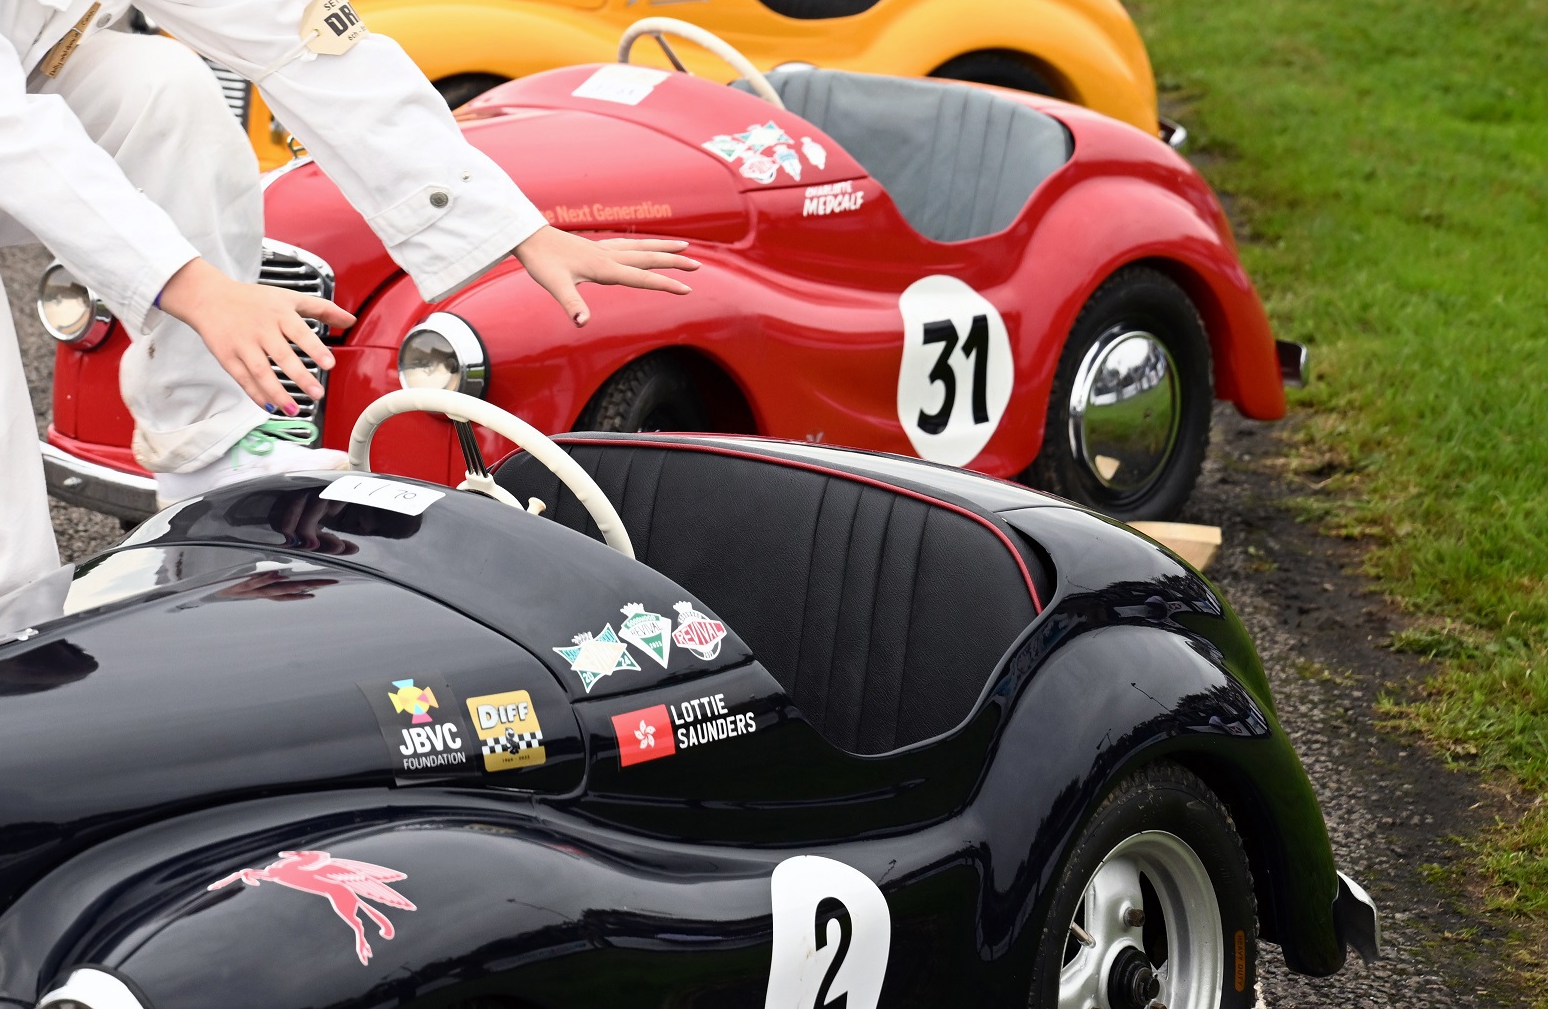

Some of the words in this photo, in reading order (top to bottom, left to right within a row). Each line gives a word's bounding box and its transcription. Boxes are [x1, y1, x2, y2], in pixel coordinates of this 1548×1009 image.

[555, 204, 592, 223] Next
[592, 201, 672, 221] Generation
[803, 191, 865, 217] MEDCALF
[916, 313, 989, 435] 31
[630, 622, 663, 637] REVIVAL
[676, 621, 724, 646] REVIVAL
[583, 671, 594, 683] 20
[476, 701, 530, 730] DIFF
[670, 693, 729, 726] LOTTIE
[399, 722, 463, 756] JBVC
[677, 711, 757, 749] SAUNDERS
[403, 751, 467, 771] FOUNDATION
[813, 896, 853, 1009] 2
